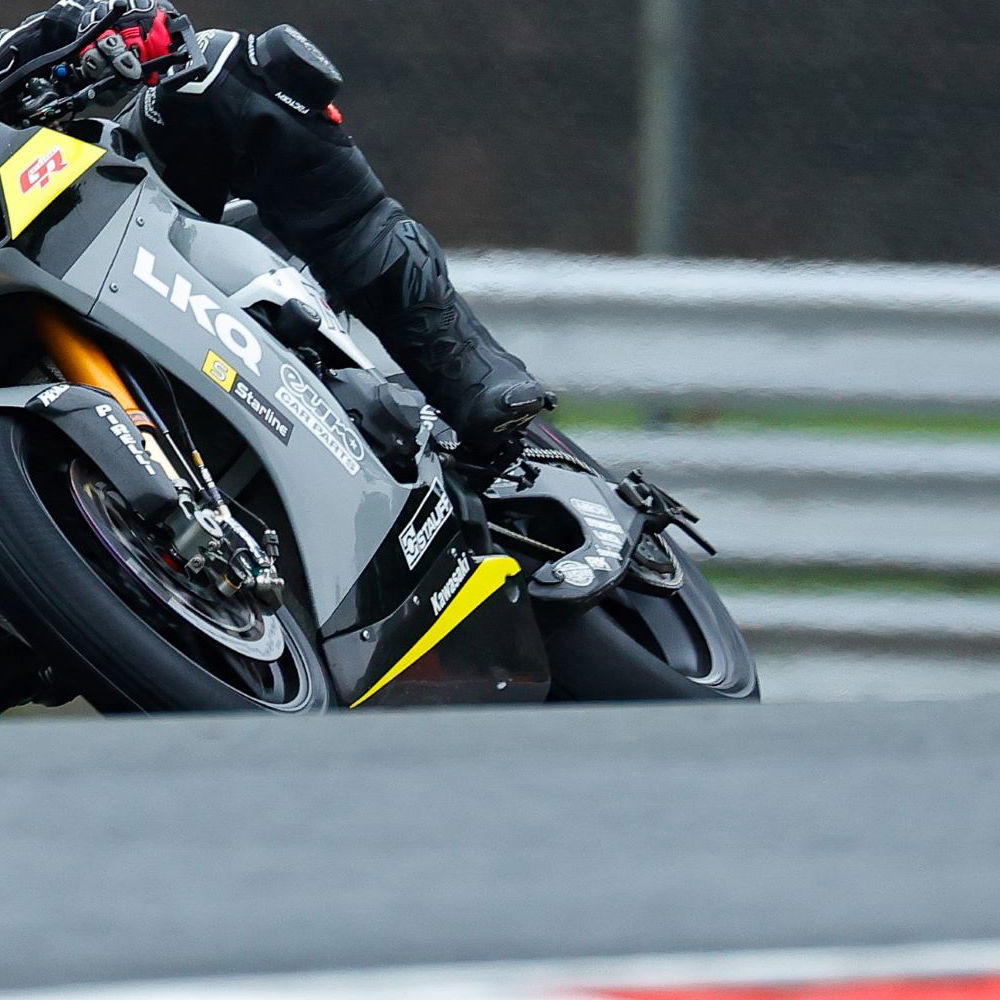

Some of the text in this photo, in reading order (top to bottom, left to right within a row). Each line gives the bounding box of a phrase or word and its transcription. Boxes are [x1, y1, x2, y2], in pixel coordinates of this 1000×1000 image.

[133, 247, 263, 376] LKQ
[96, 403, 156, 476] PIRELLI
[234, 381, 288, 438] Starline
[284, 391, 359, 473] CAR PARTS
[430, 553, 471, 616] Kawasaki
